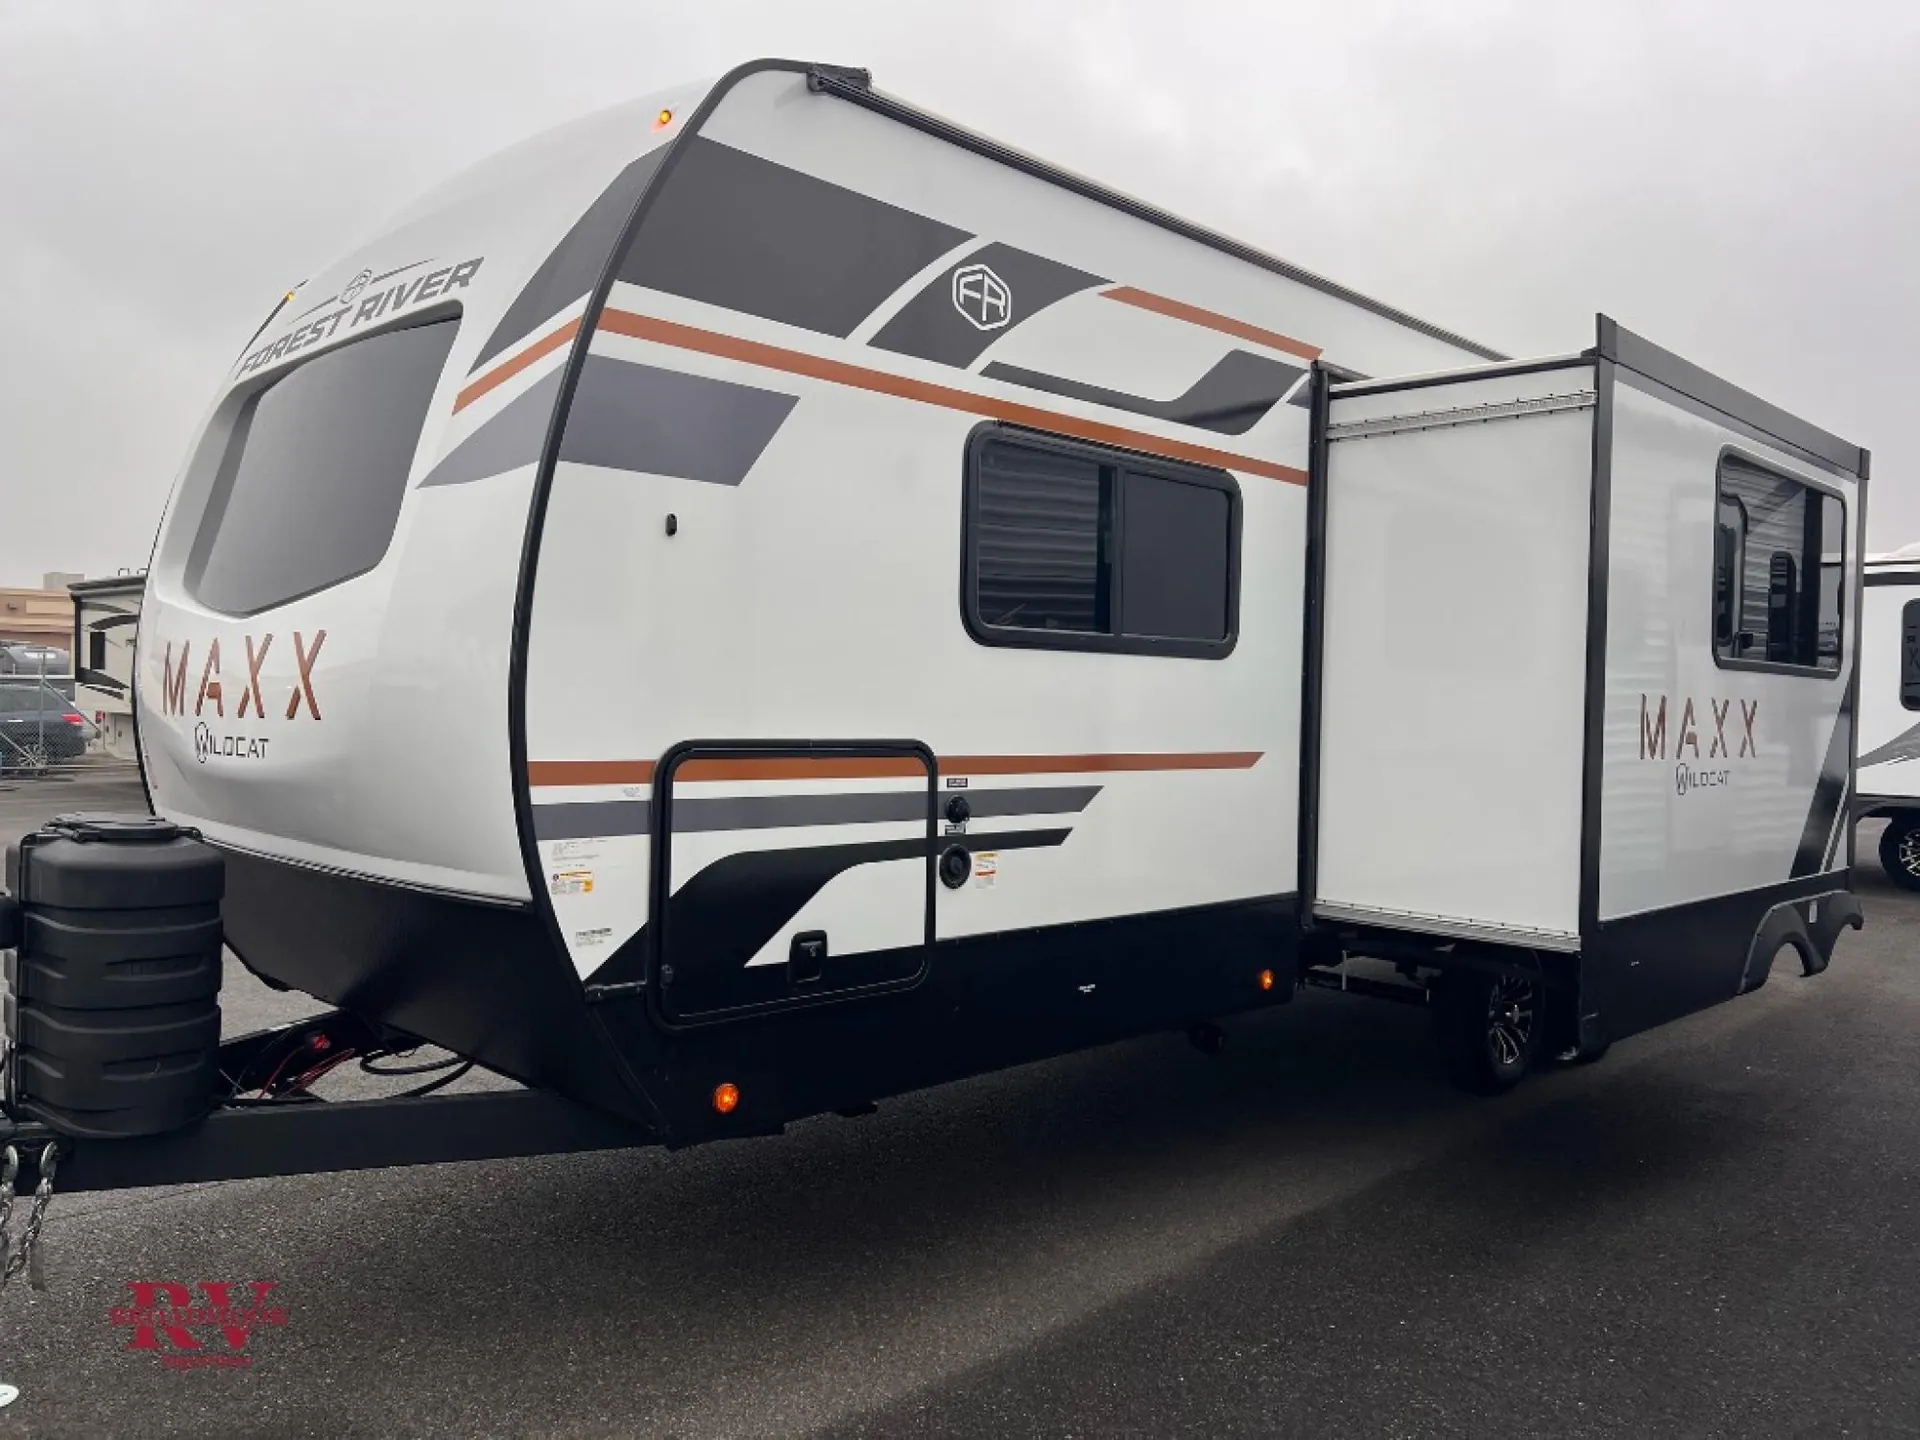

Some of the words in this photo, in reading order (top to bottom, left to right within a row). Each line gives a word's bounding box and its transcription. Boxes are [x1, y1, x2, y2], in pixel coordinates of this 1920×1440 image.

[235, 305, 352, 380] FOREST
[351, 257, 484, 327] RIVER
[163, 630, 327, 720] MAXX
[1640, 693, 1757, 759] MAXX
